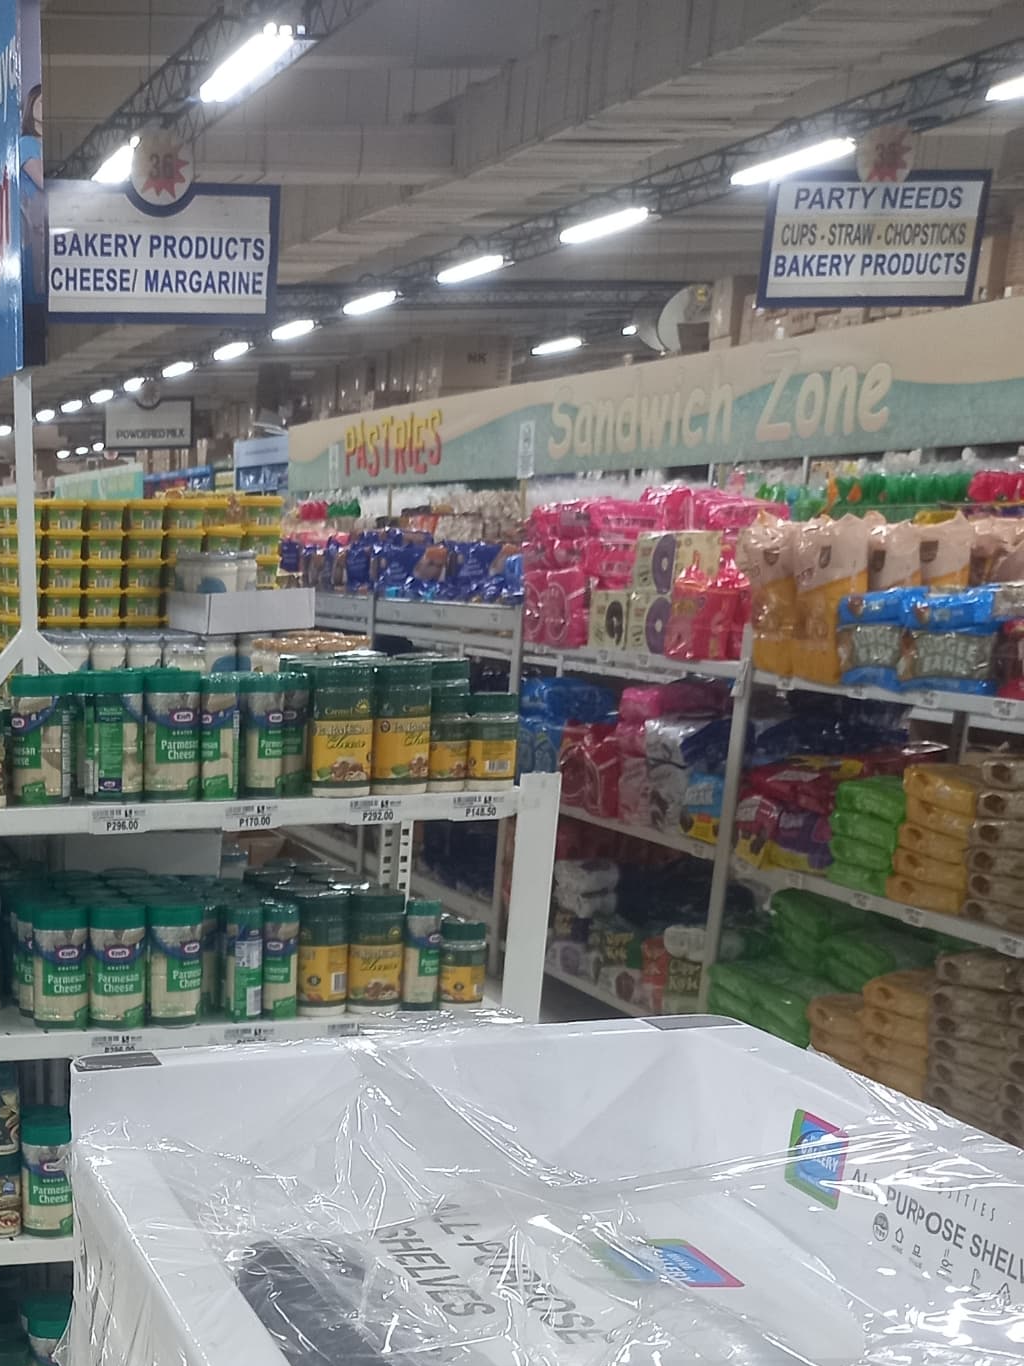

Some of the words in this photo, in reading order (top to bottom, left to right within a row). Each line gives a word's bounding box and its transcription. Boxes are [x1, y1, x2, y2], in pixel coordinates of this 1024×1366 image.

[794, 187, 877, 210] PARTY
[880, 186, 964, 209] NEEDS
[780, 223, 818, 246] CUPS
[827, 223, 876, 246] STRAW
[884, 222, 968, 245] CHOPSTICKS
[53, 233, 142, 258] BAKERY
[148, 235, 266, 261] PRODUCTS
[773, 253, 856, 278] BAKERY
[859, 252, 967, 276] PRODUCTS
[50, 267, 138, 292] CHEESE/
[144, 269, 264, 295] MARGARINE
[546, 384, 739, 463] Sandwich
[754, 350, 894, 443] Zone
[343, 408, 444, 477] PASTRIES
[239, 816, 271, 827] P170.00
[362, 811, 394, 822] P292.00
[465, 807, 497, 818] P148.50
[107, 948, 131, 959] Kraft
[47, 973, 87, 985] Parmesan
[53, 982, 83, 994] Cheese
[97, 972, 140, 984] Parmesan
[103, 982, 135, 993] Cheese
[887, 1187, 967, 1249] PURPOSE
[378, 1226, 497, 1317] SHELVES
